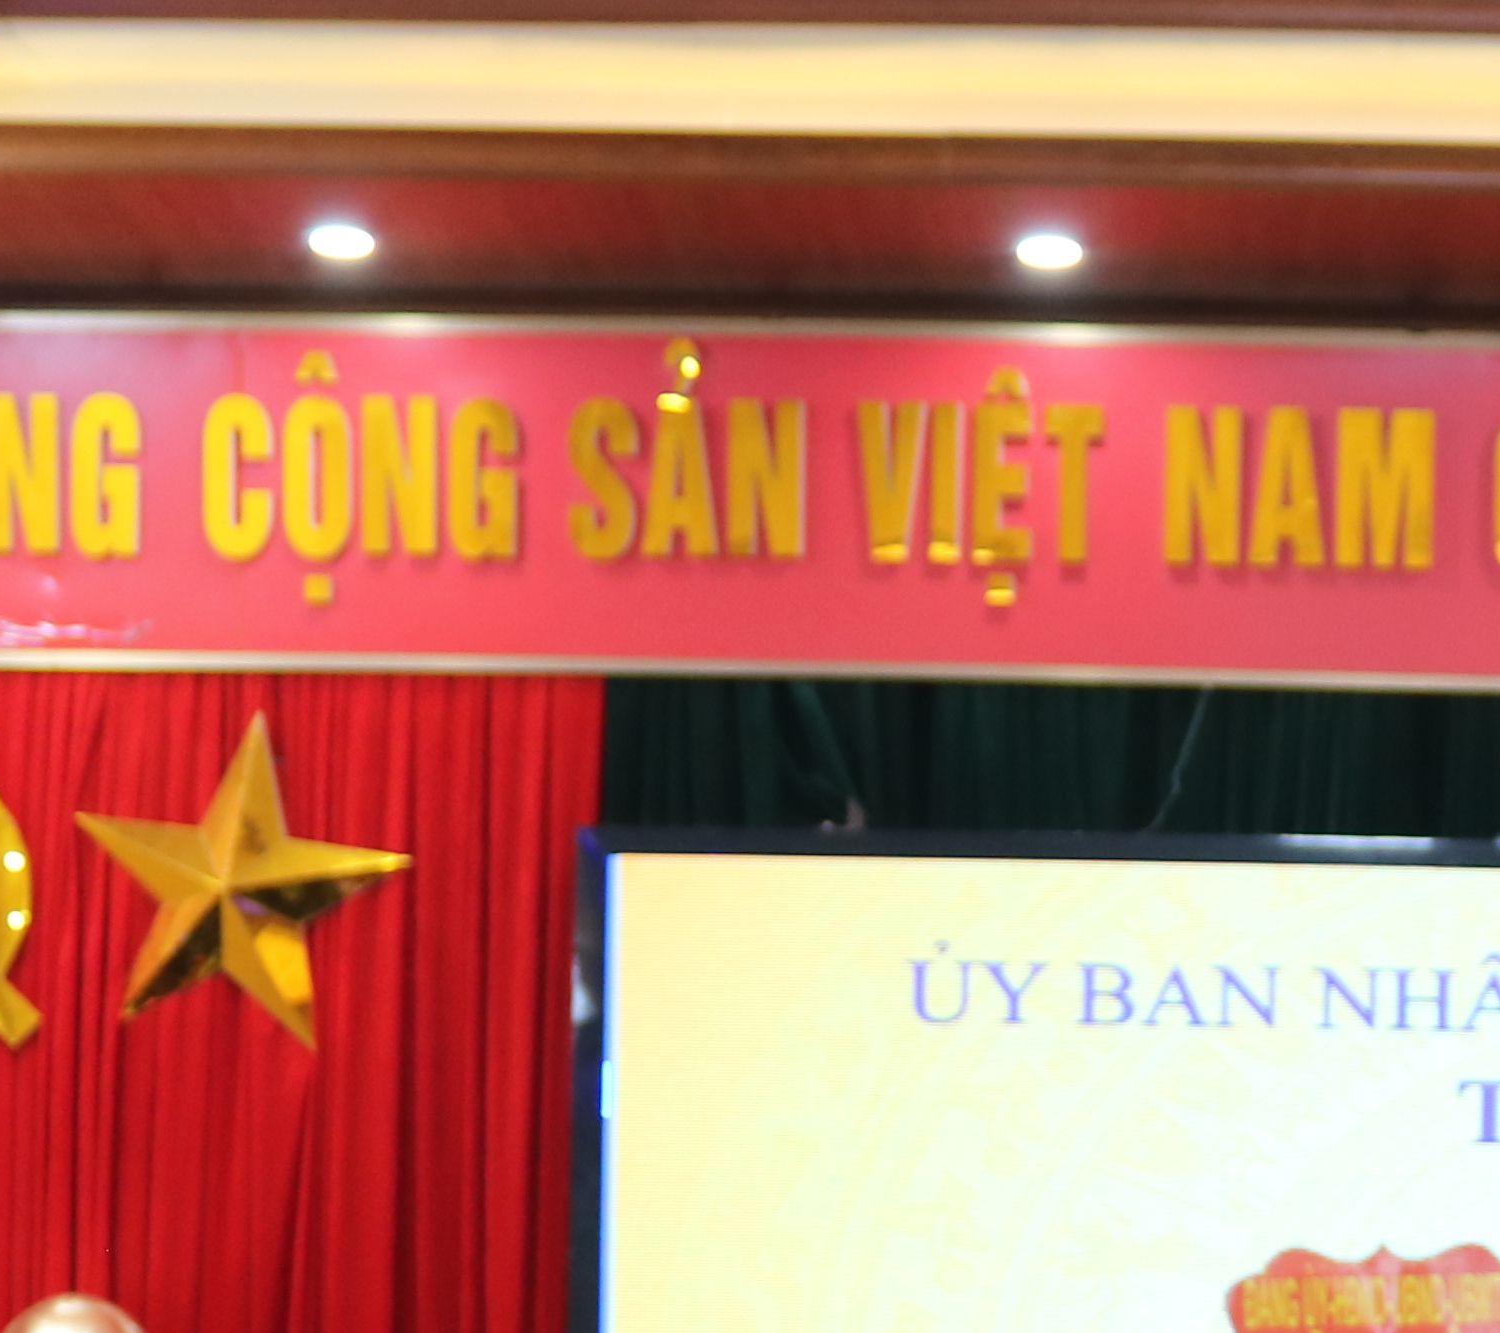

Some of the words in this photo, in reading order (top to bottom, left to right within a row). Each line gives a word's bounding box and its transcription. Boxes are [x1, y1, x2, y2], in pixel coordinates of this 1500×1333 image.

[201, 349, 521, 606] CỘNG
[569, 337, 808, 562] SẢN
[857, 364, 1107, 608] VIỆT
[1164, 404, 1436, 571] NAM
[907, 940, 1047, 1027] ỦY
[1076, 962, 1281, 1028] BAN
